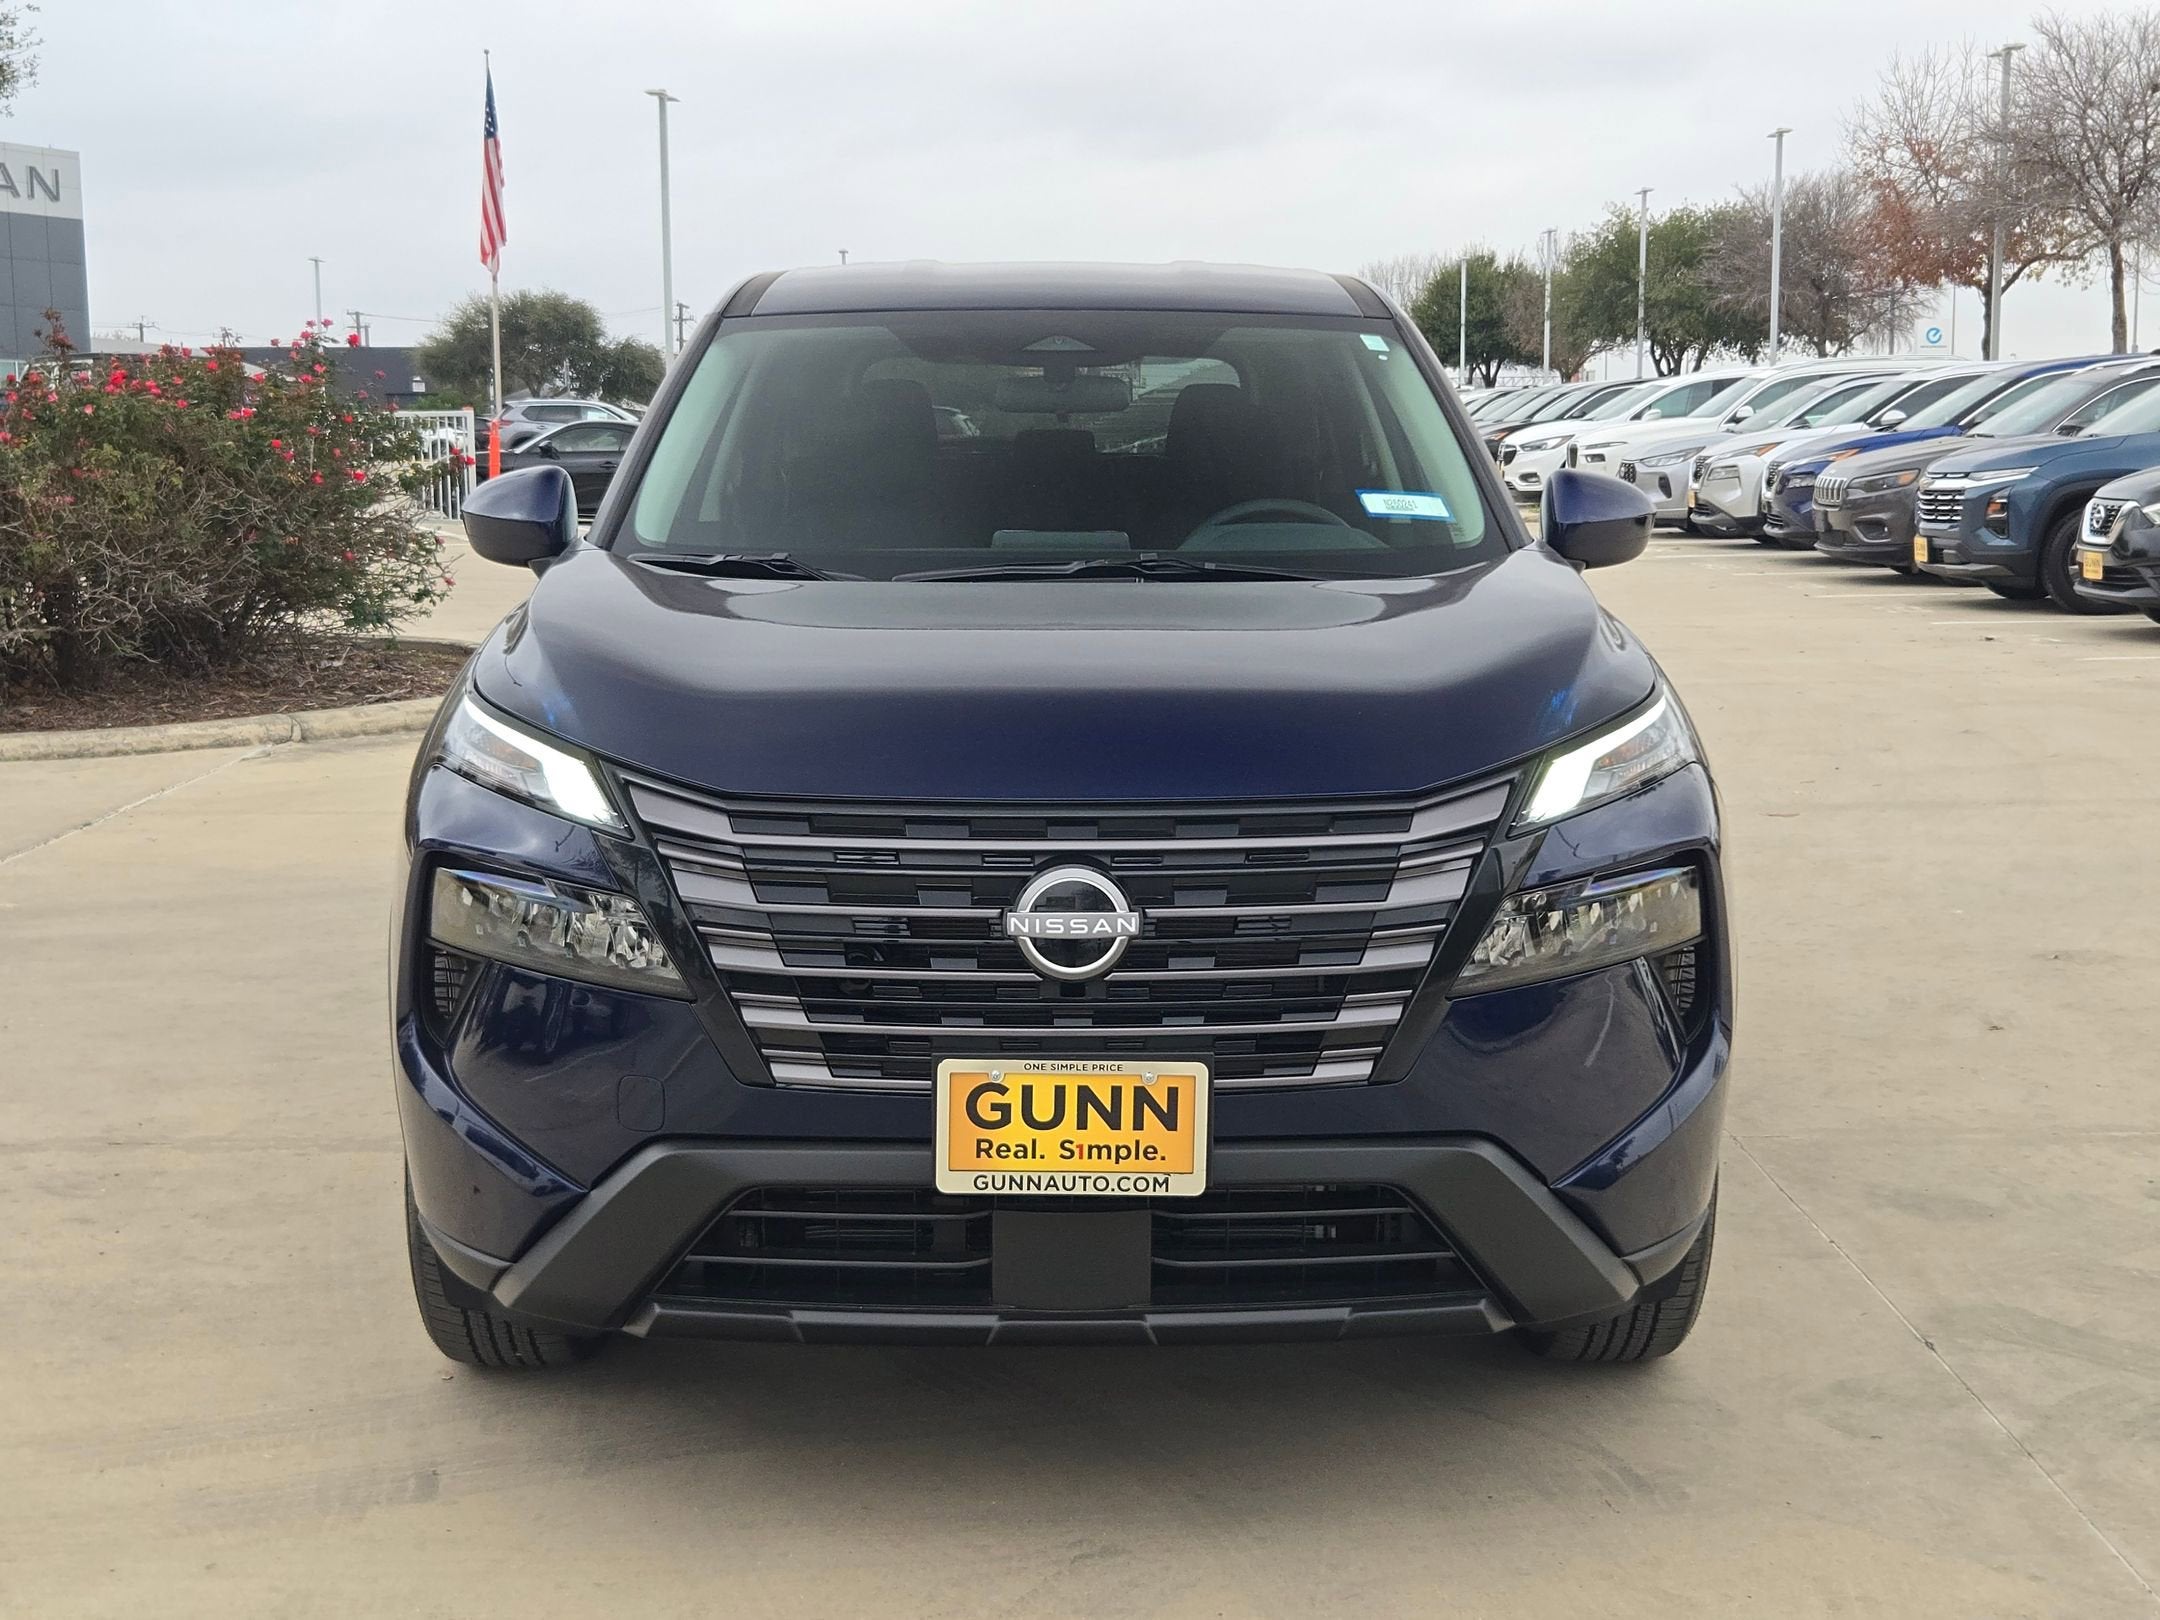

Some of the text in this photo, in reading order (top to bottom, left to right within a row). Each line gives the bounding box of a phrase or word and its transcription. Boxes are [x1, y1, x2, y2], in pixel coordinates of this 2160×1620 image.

[1010, 917, 1136, 934] NISSAN
[1023, 1062, 1124, 1072] ONE SIMPLE PRICE
[965, 1081, 1179, 1132] GUNN
[975, 1138, 1046, 1160] Real.
[973, 1174, 1170, 1193] GUNNAUTO.COM
